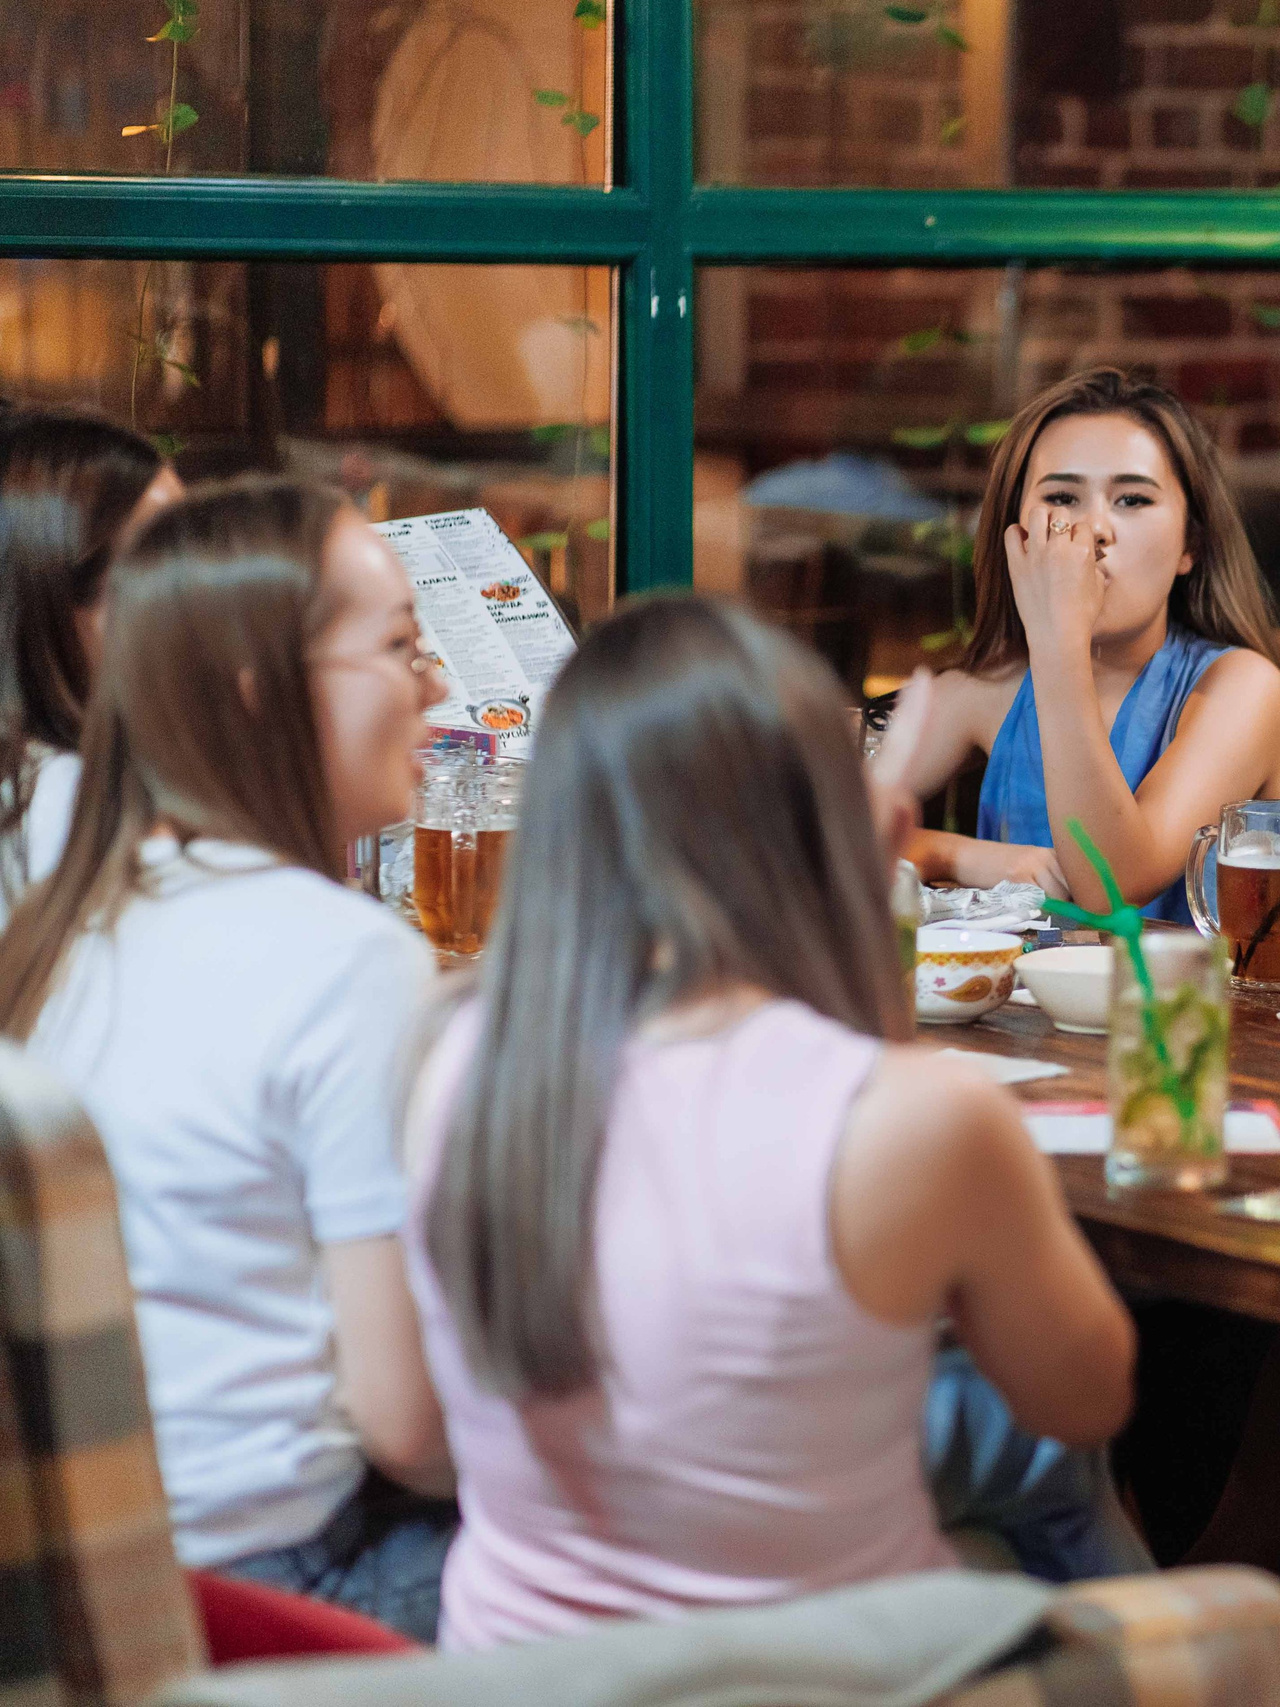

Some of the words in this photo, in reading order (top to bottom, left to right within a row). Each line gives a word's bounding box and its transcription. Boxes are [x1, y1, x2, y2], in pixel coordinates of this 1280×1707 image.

[416, 575, 458, 586] САЛАТЫ
[486, 601, 524, 611] БЛЮДА
[495, 612, 550, 624] КОМПАНИЮ
[498, 729, 531, 740] КУСКИ
